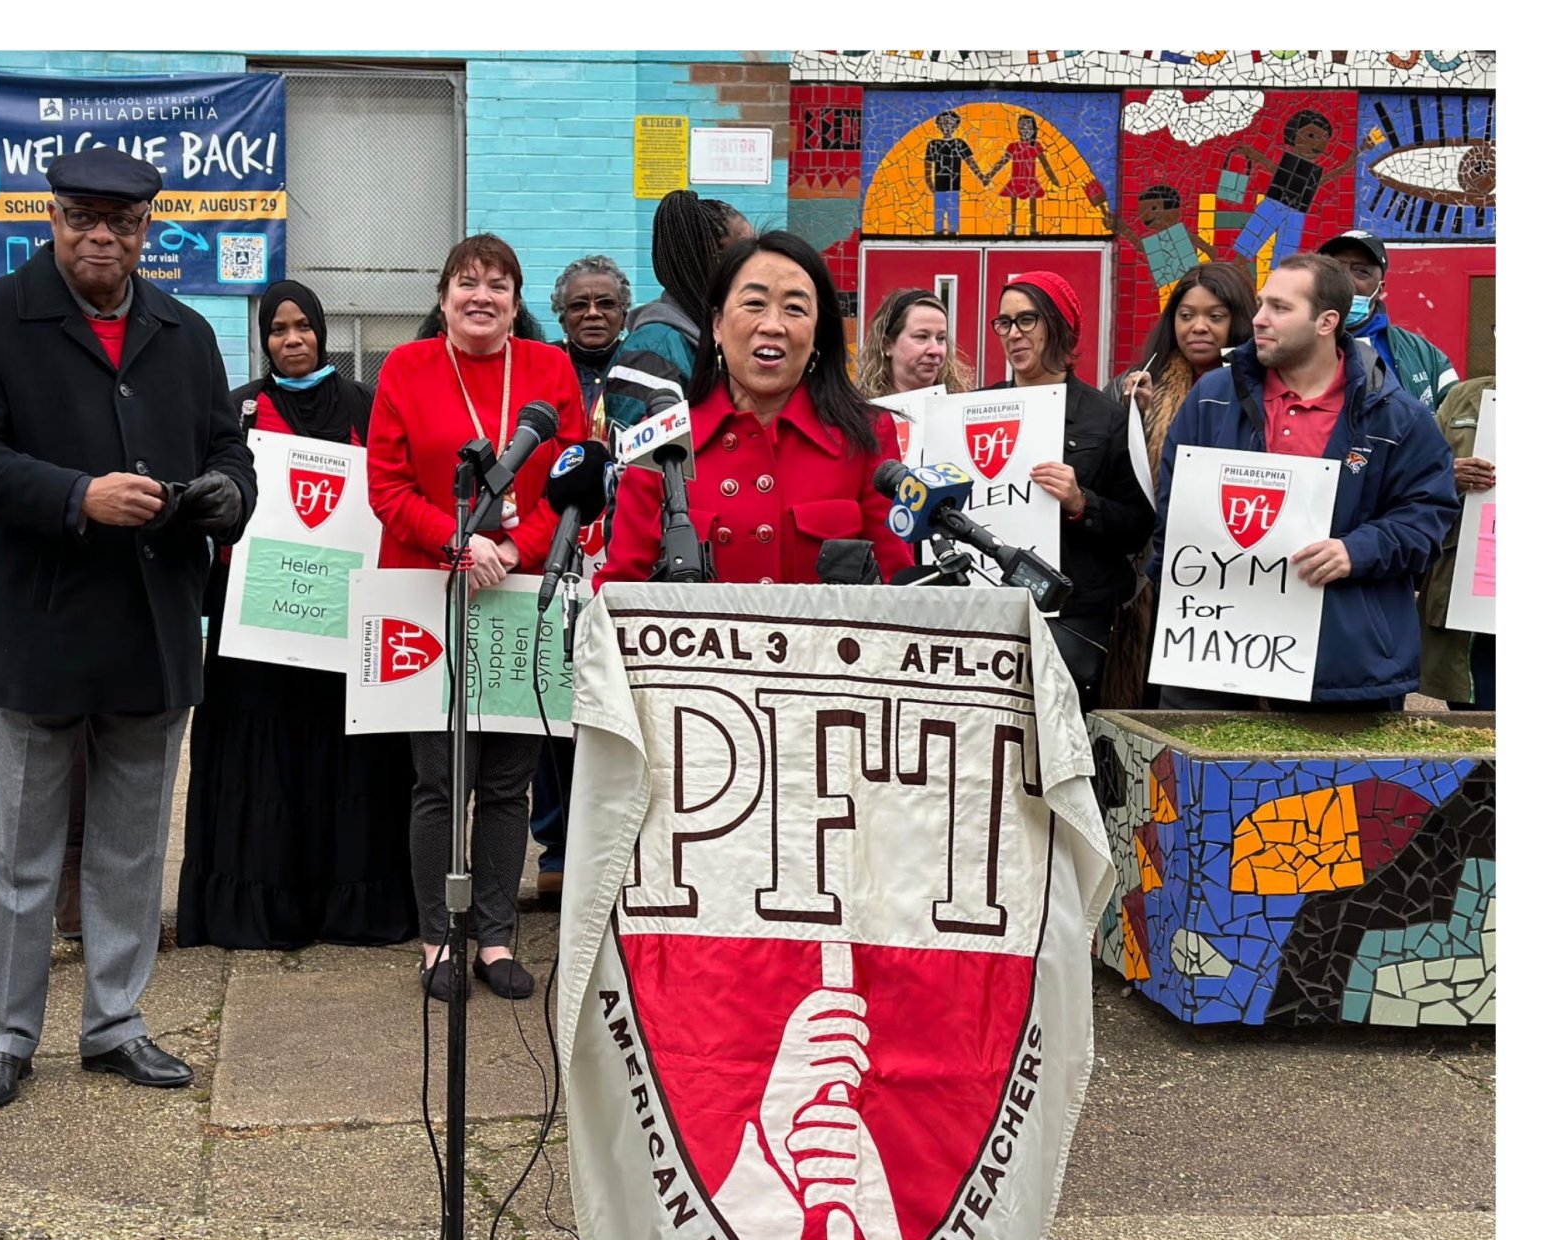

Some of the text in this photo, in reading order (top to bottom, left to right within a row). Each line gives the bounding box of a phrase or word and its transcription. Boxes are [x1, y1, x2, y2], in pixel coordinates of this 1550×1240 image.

[69, 95, 216, 106] THE SCHOOL DISTRICT OF
[69, 106, 218, 121] PHILADELPHIA
[646, 118, 677, 127] NOTICE
[179, 131, 278, 179] BACK!
[4, 198, 278, 215] SCHO NDAY, AUGUST 29
[147, 254, 159, 263] or
[159, 253, 180, 263] visit
[966, 404, 1020, 415] PHILADELPHIA
[633, 427, 655, 447] 10
[674, 417, 688, 428] 62
[972, 427, 1014, 468] pft
[292, 452, 346, 467] PHILADELPHIA
[565, 456, 584, 465] abc
[1224, 467, 1286, 480] PHILADELPHIA
[295, 479, 338, 516] pft
[899, 476, 928, 512] 3
[969, 480, 1032, 511] LEN
[1226, 494, 1276, 535] pft
[280, 556, 329, 577] Helen
[1170, 545, 1289, 594] GYM
[290, 578, 314, 596] for
[271, 599, 327, 620] Mayor
[1176, 595, 1235, 620] for
[363, 620, 373, 683] PHILADELPHIA
[388, 625, 430, 673] pft
[488, 616, 506, 689] support
[510, 627, 529, 682] Helen
[616, 624, 1034, 686] LOCAL 3 AFL-CI
[1162, 626, 1305, 674] MAYOR
[622, 684, 1042, 937] PFT
[597, 989, 701, 1231] AMERICAN
[951, 1025, 1043, 1239] TEACHERS
